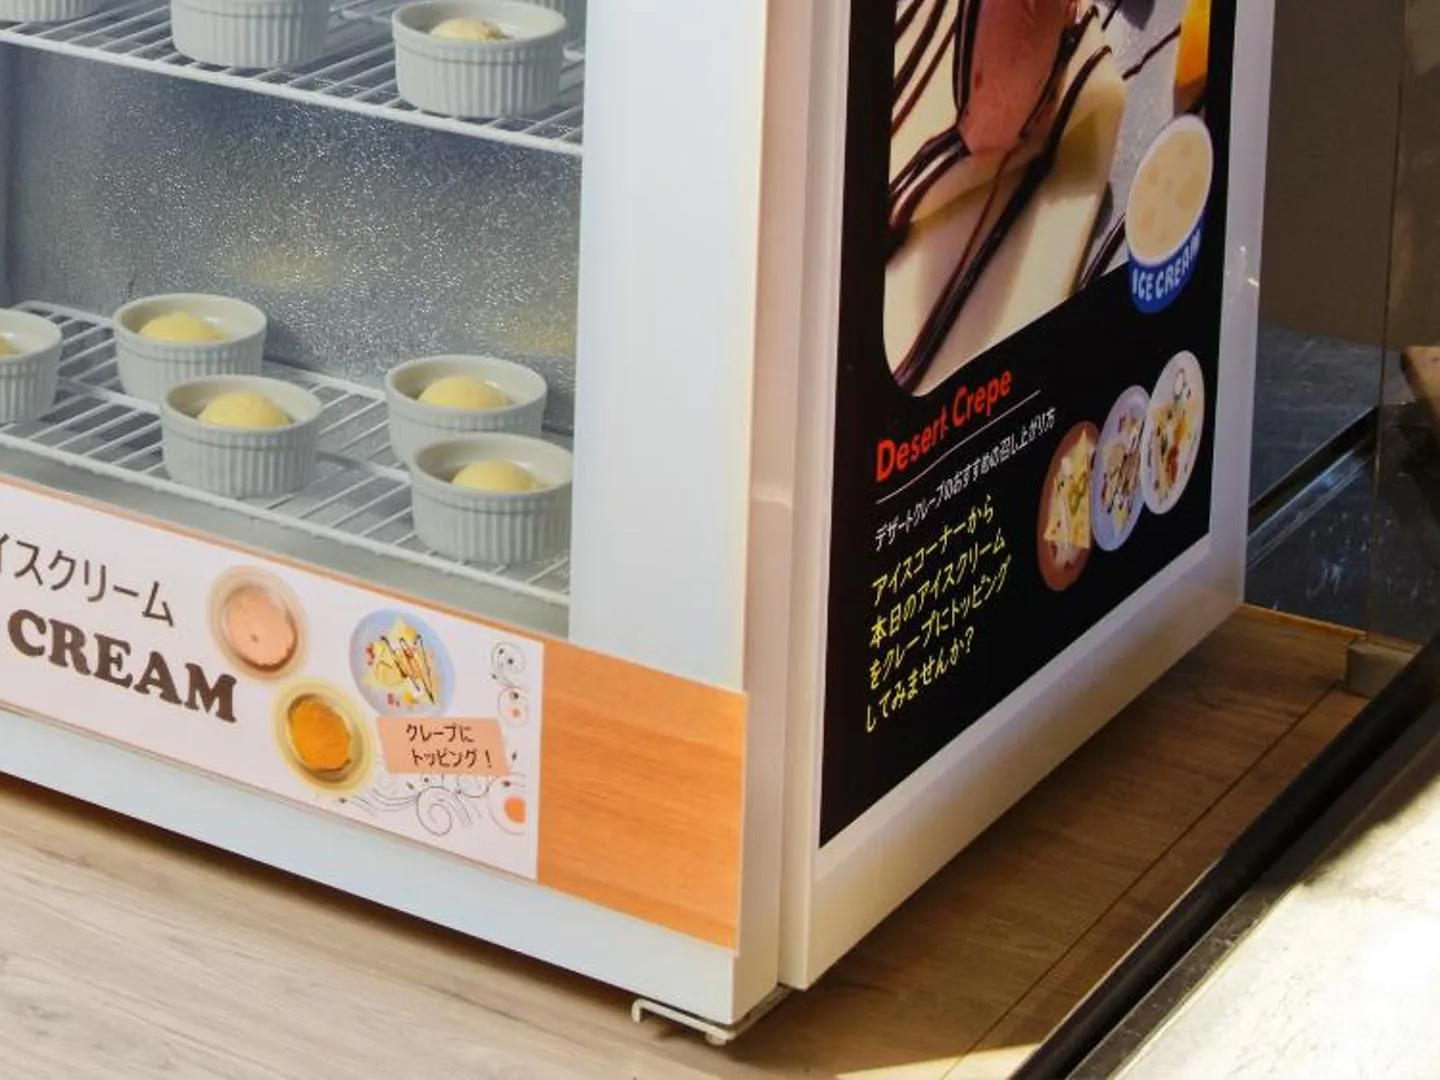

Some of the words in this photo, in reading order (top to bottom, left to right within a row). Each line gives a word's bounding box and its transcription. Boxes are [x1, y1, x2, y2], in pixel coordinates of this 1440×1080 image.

[875, 405, 949, 483] Desert
[951, 369, 1012, 428] Crepe
[870, 526, 1006, 648] 本日のアイスクリーム
[871, 493, 994, 607] アイスコーナーから
[7, 608, 238, 723] CREAM
[869, 553, 1013, 690] をクレープにトッピング
[405, 723, 475, 742] クレープに
